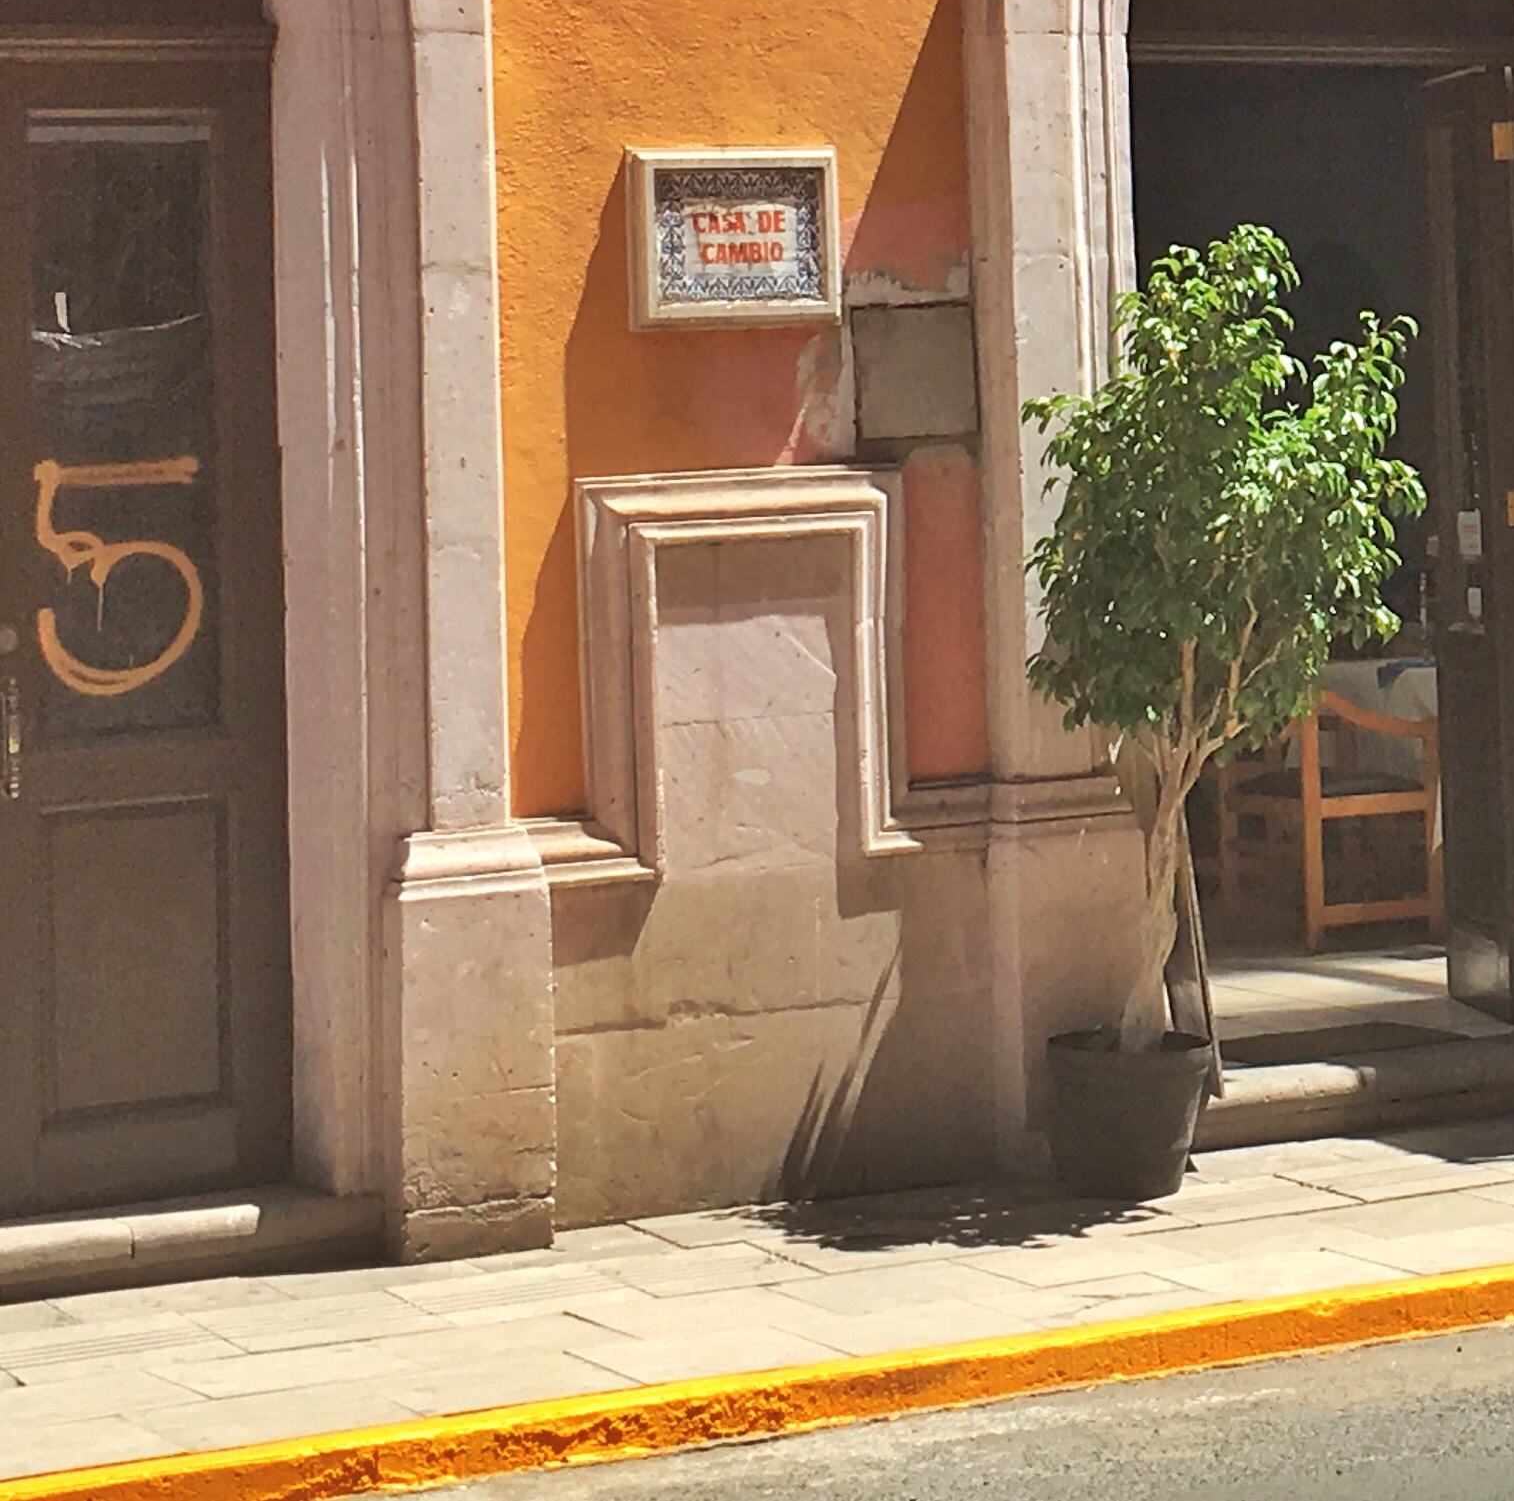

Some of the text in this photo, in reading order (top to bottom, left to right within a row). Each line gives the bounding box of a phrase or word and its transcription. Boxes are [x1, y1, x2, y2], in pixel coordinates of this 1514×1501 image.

[692, 209, 786, 234] CASA DE
[701, 242, 784, 264] CAMBIO
[34, 457, 203, 696] 5
